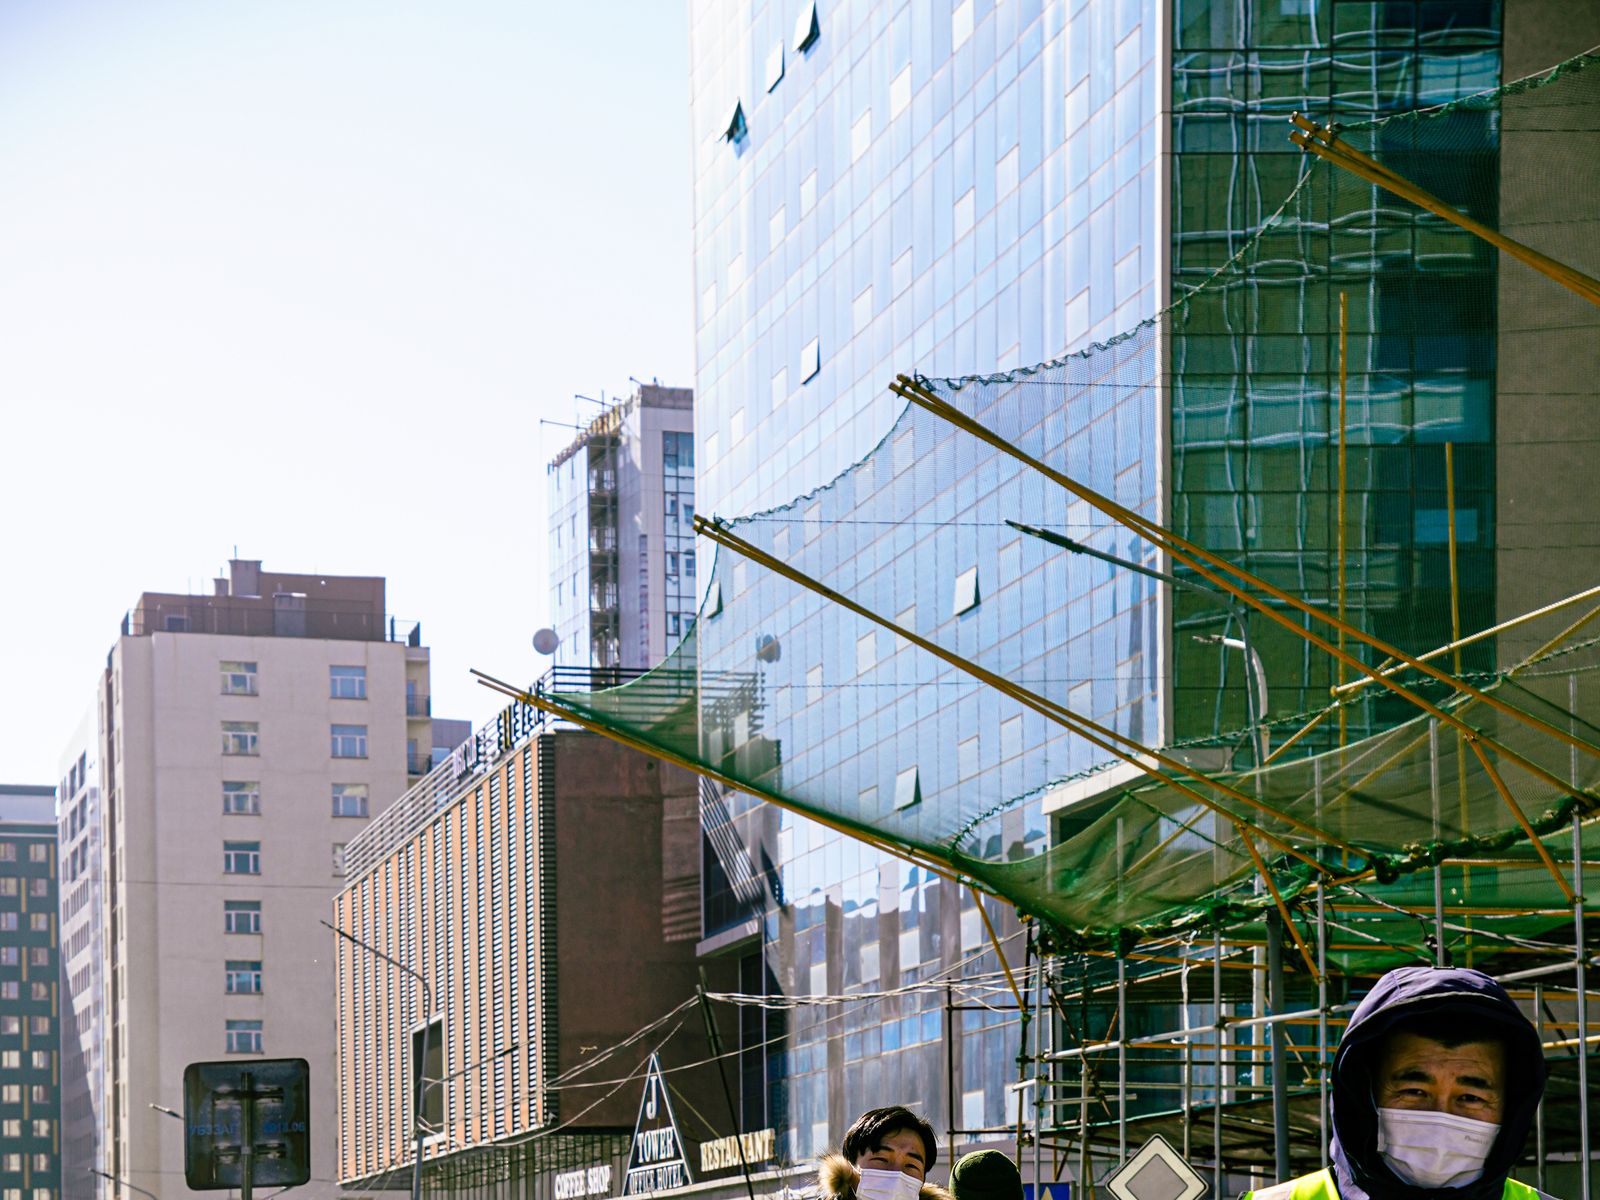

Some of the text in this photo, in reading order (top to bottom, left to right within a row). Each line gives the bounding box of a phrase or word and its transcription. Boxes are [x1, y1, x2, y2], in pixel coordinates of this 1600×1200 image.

[646, 1075, 658, 1120] J
[637, 1126, 675, 1163] TOWER
[555, 1165, 611, 1200] COFFEE SHOP
[629, 1164, 684, 1195] OFFICE HOTEL
